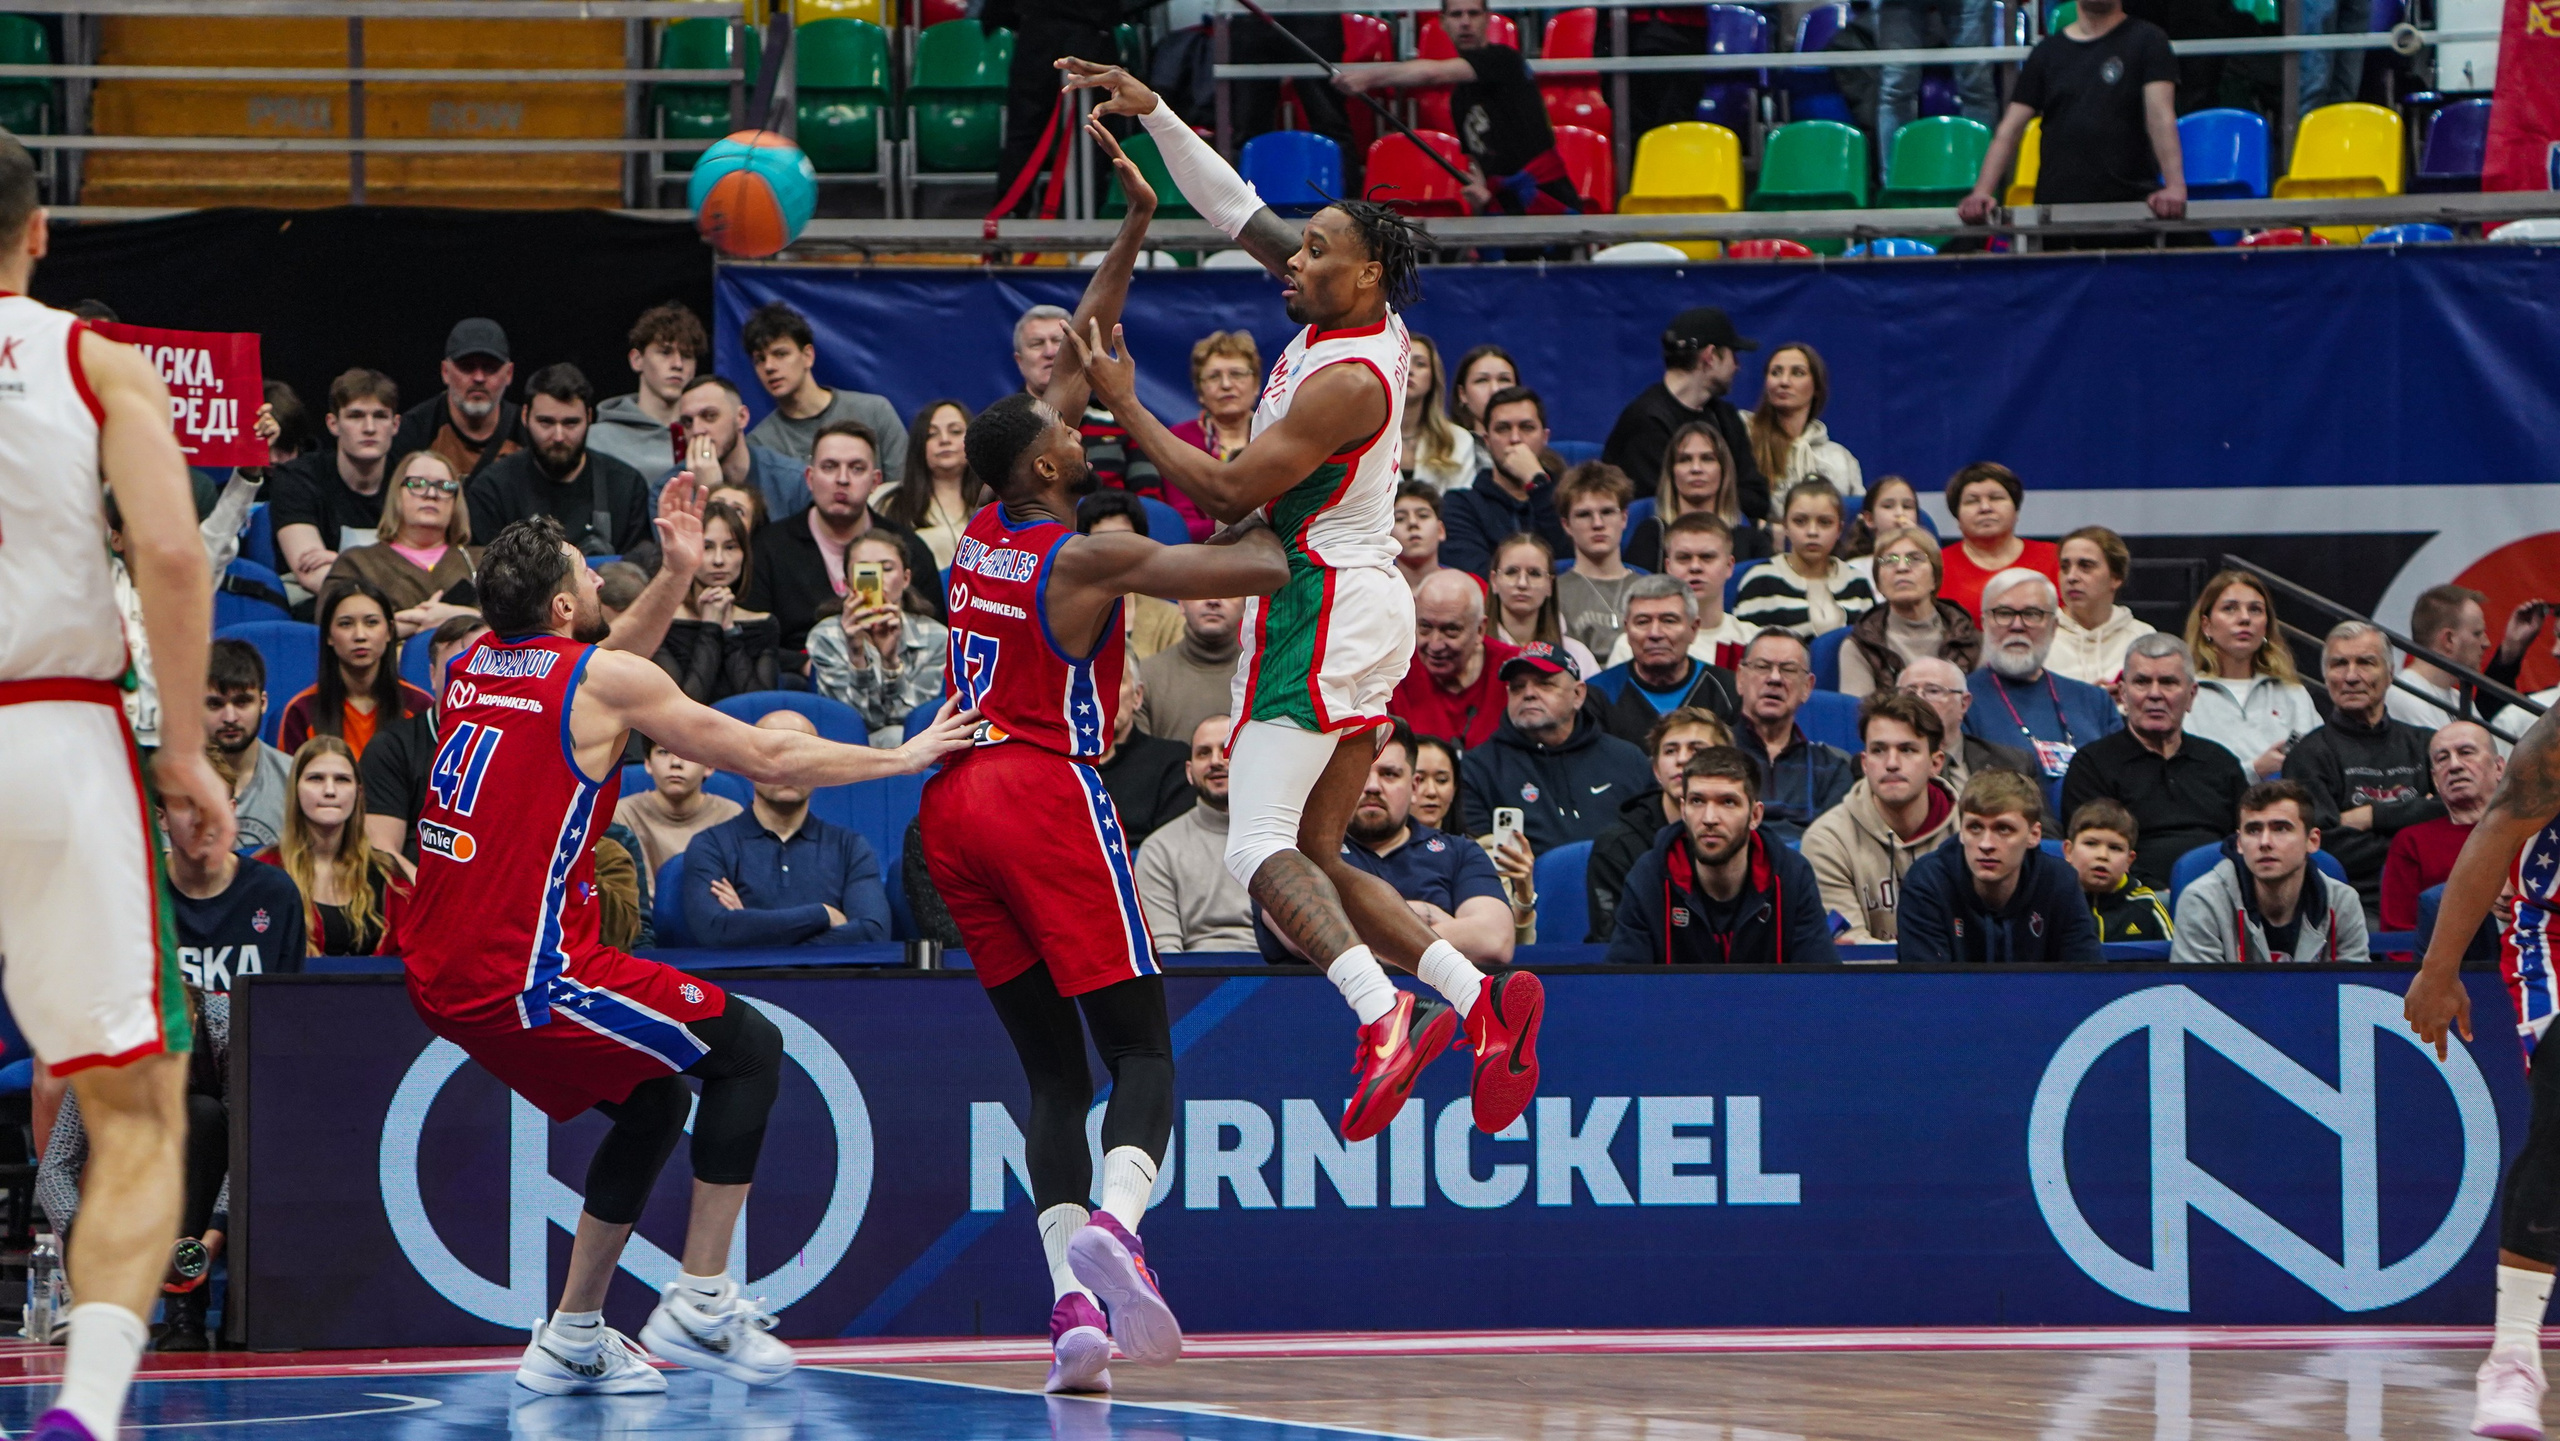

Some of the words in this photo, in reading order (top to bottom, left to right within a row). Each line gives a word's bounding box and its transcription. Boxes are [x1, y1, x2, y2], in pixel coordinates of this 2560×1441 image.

[429, 100, 523, 131] ROW
[169, 387, 239, 443] РЁД!
[951, 626, 1000, 713] 17
[476, 693, 543, 713] НОРНИКЕЛЬ
[430, 720, 503, 817] 41
[177, 944, 263, 991] SKA
